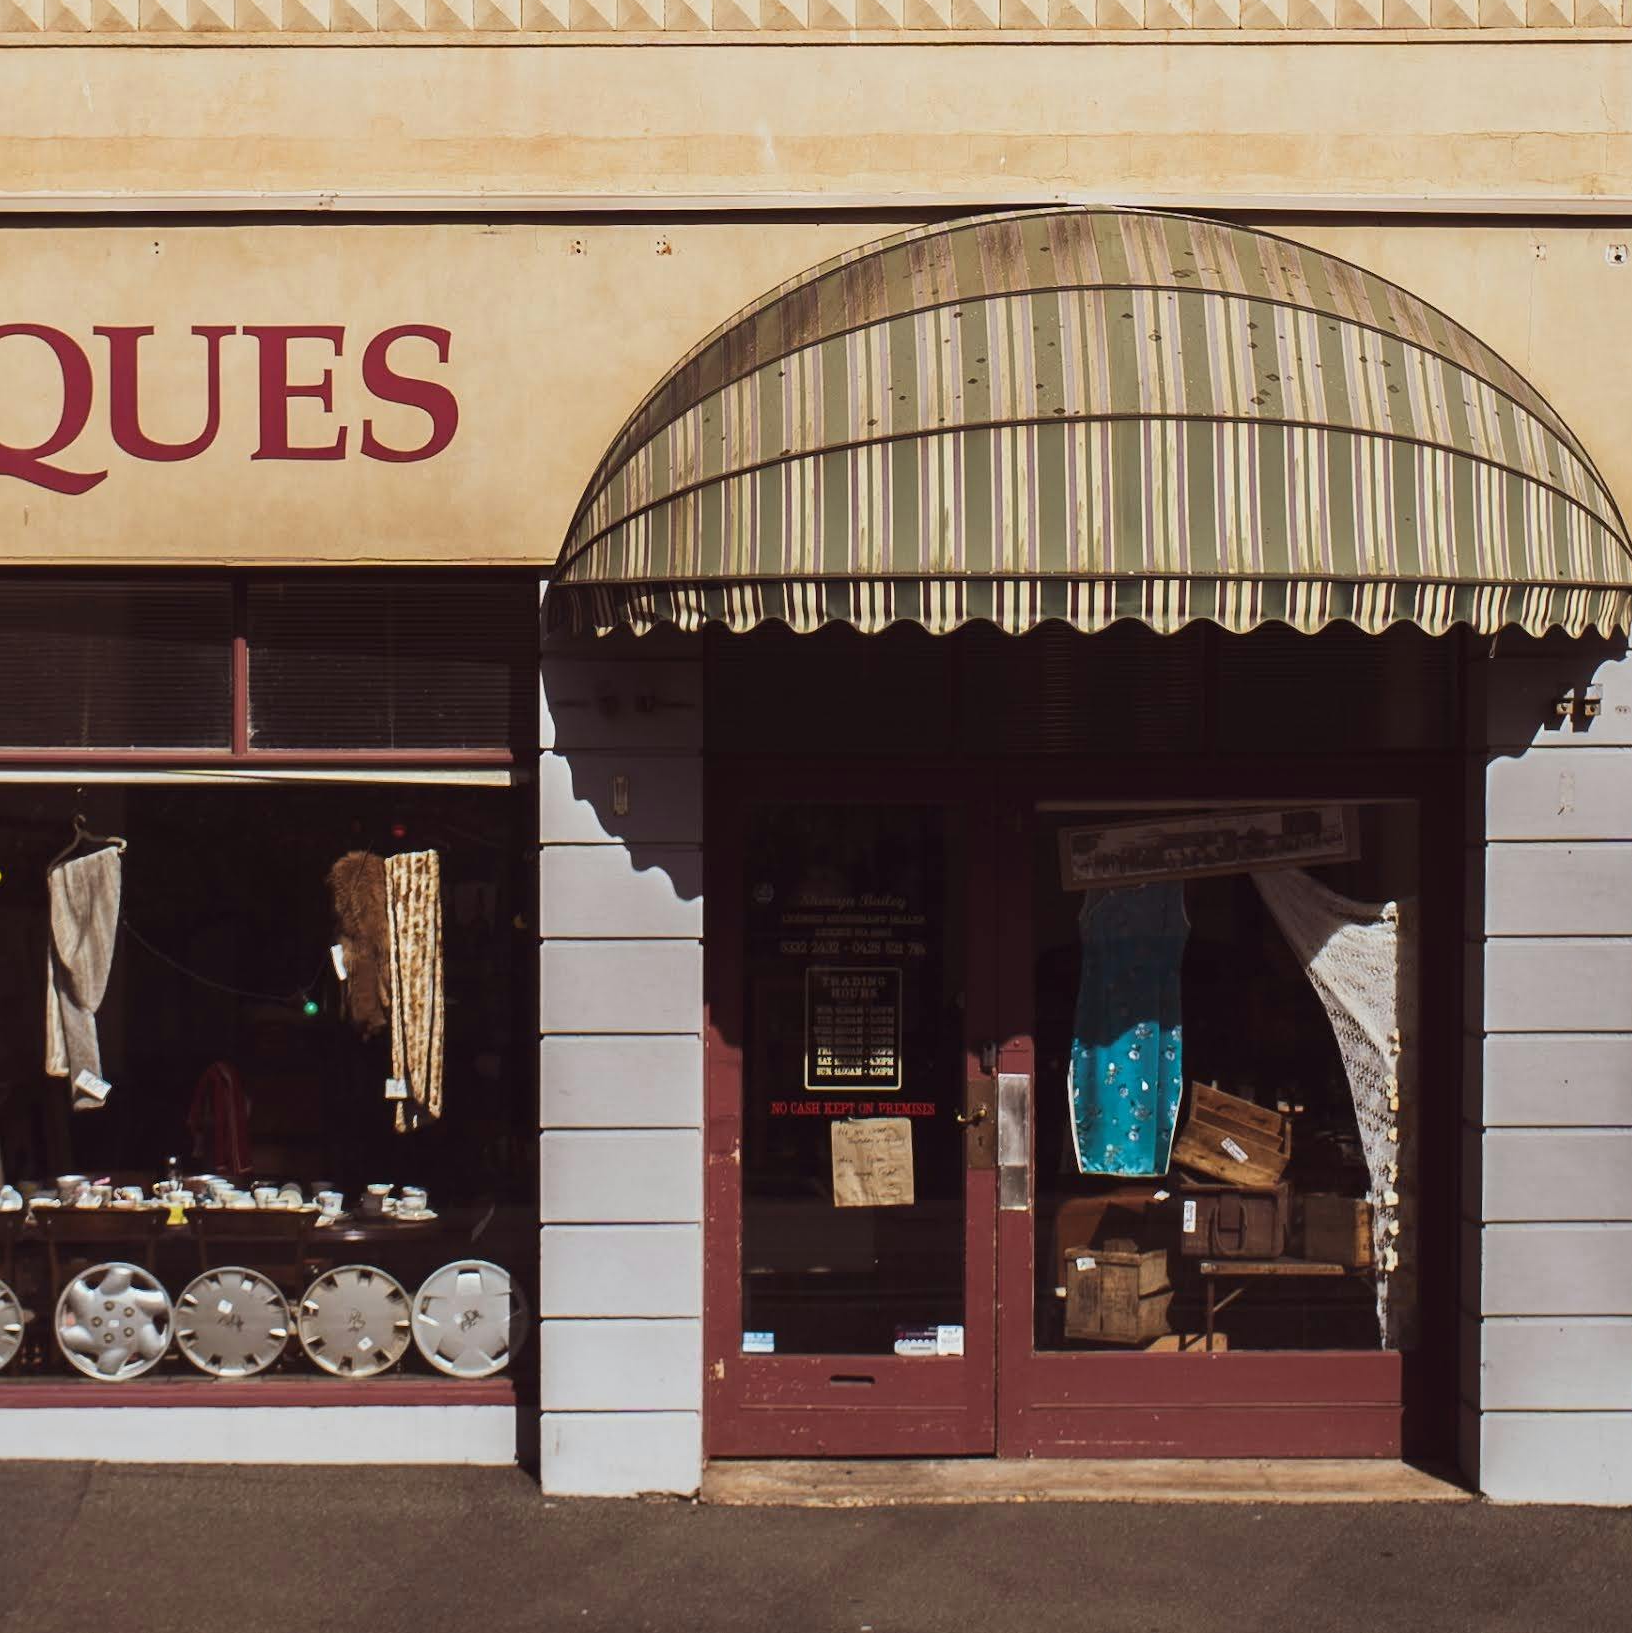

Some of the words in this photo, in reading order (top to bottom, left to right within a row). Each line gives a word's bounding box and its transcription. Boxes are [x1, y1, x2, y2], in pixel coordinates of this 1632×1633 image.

[771, 1101, 788, 1116] NO
[790, 1101, 821, 1116] CASH
[823, 1101, 856, 1116] KEPT
[858, 1102, 874, 1116] ON
[878, 1102, 936, 1116] PREMISES
